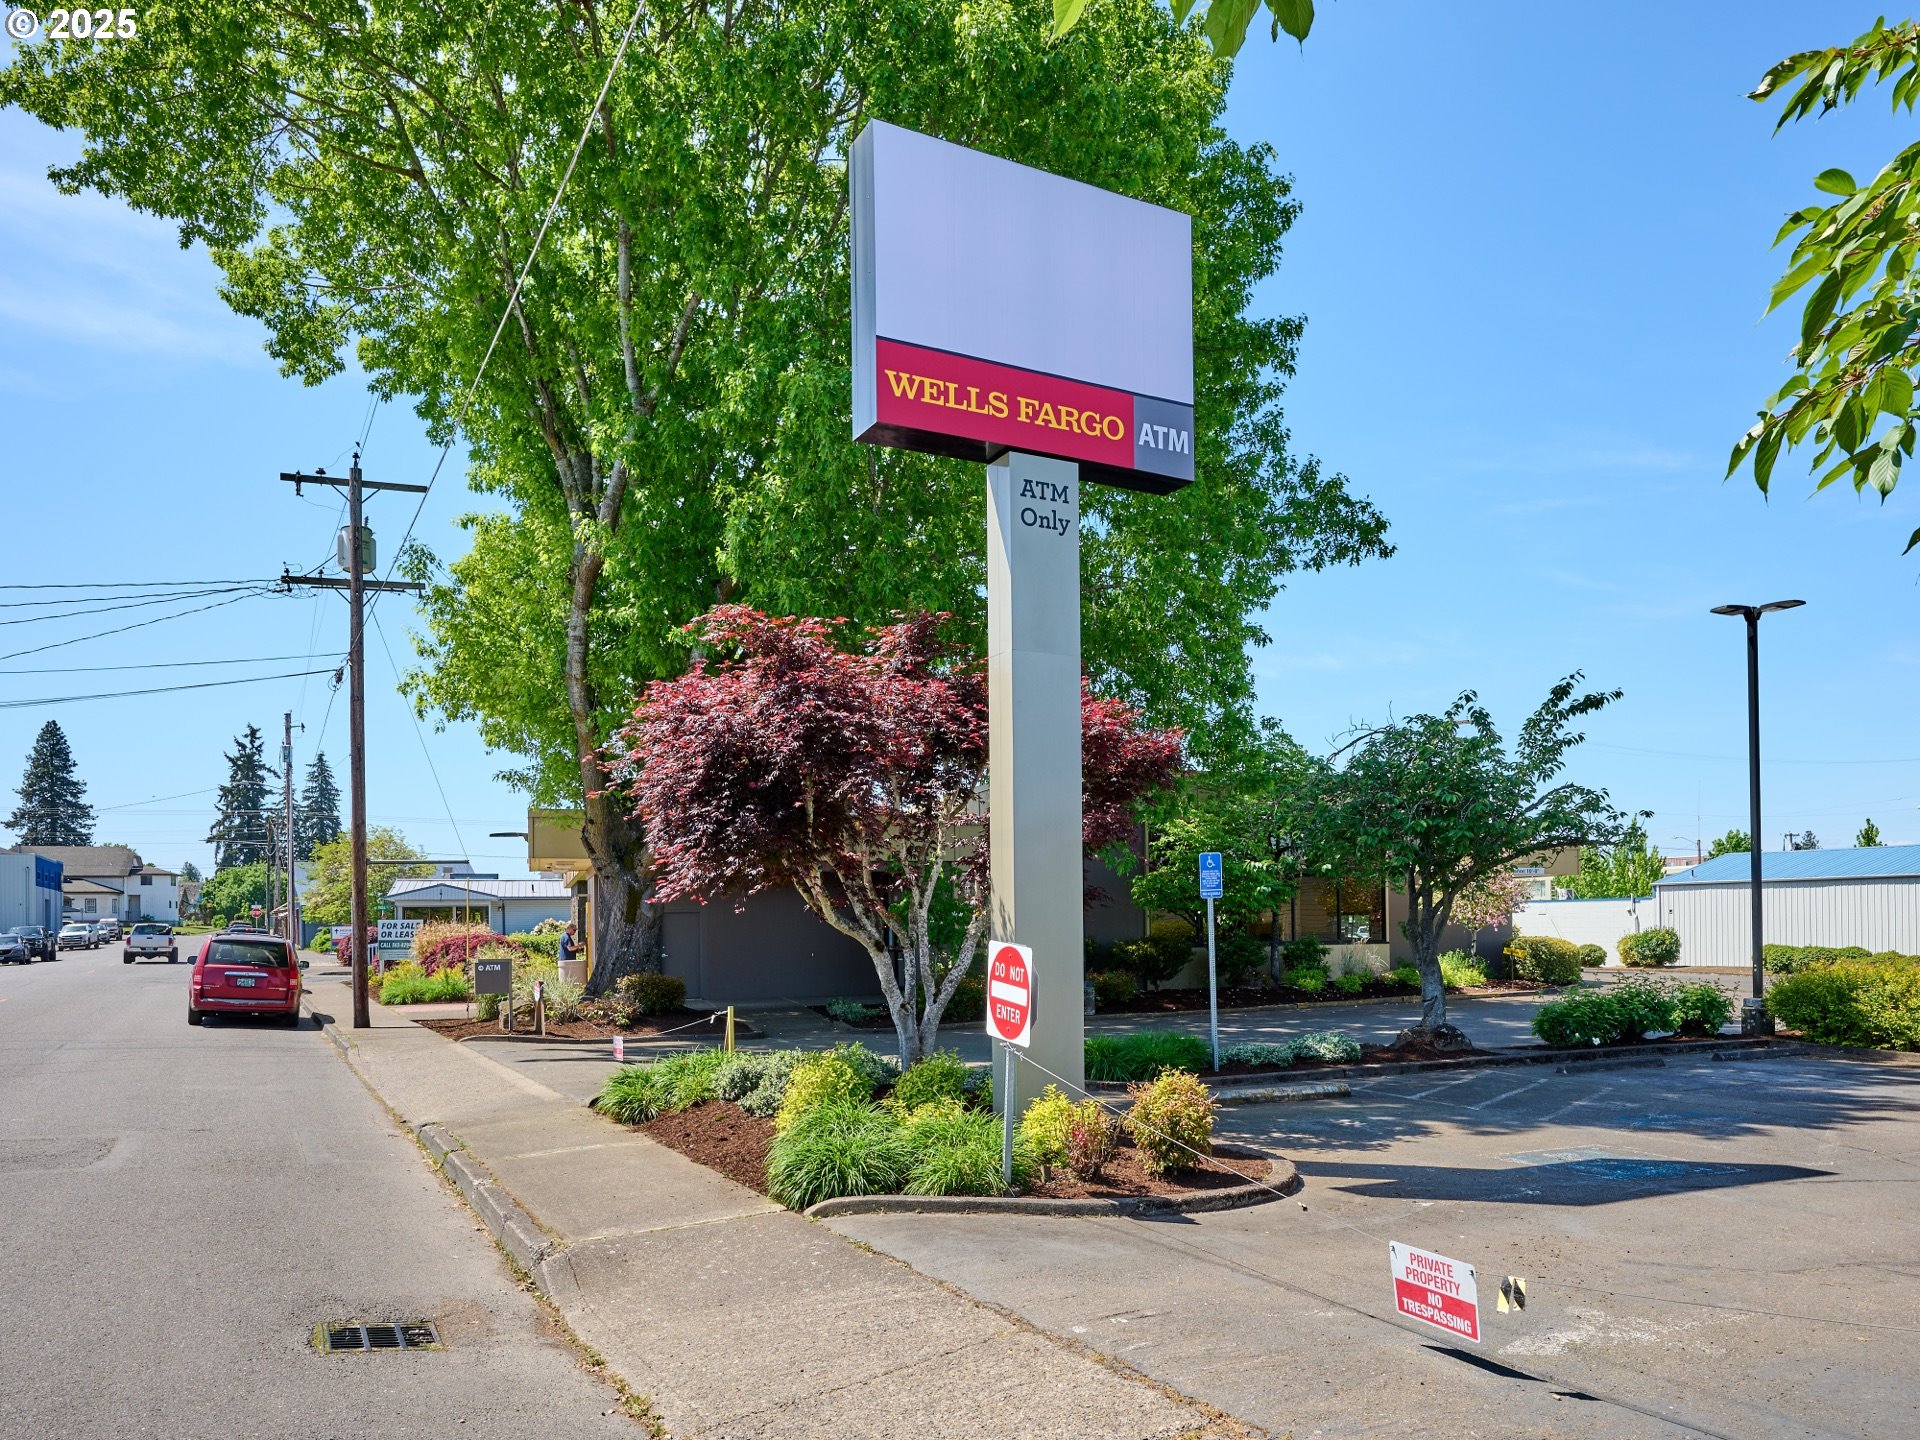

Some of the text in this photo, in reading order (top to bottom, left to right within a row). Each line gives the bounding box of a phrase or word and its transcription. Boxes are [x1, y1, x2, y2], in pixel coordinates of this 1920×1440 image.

[884, 369, 1125, 441] WELLS FARGO
[1138, 422, 1189, 454] ATM
[1020, 478, 1069, 505] ATM
[1020, 507, 1071, 537] Only
[380, 930, 417, 939] OR LEAS
[381, 922, 398, 930] FOR
[995, 961, 1025, 983] DO NOT
[996, 1003, 1021, 1025] ENTER
[1409, 1252, 1454, 1279] PRIVATE
[1405, 1266, 1461, 1297] PROPERTY
[1427, 1291, 1443, 1308] NO
[1402, 1297, 1472, 1334] TRESPASSING
